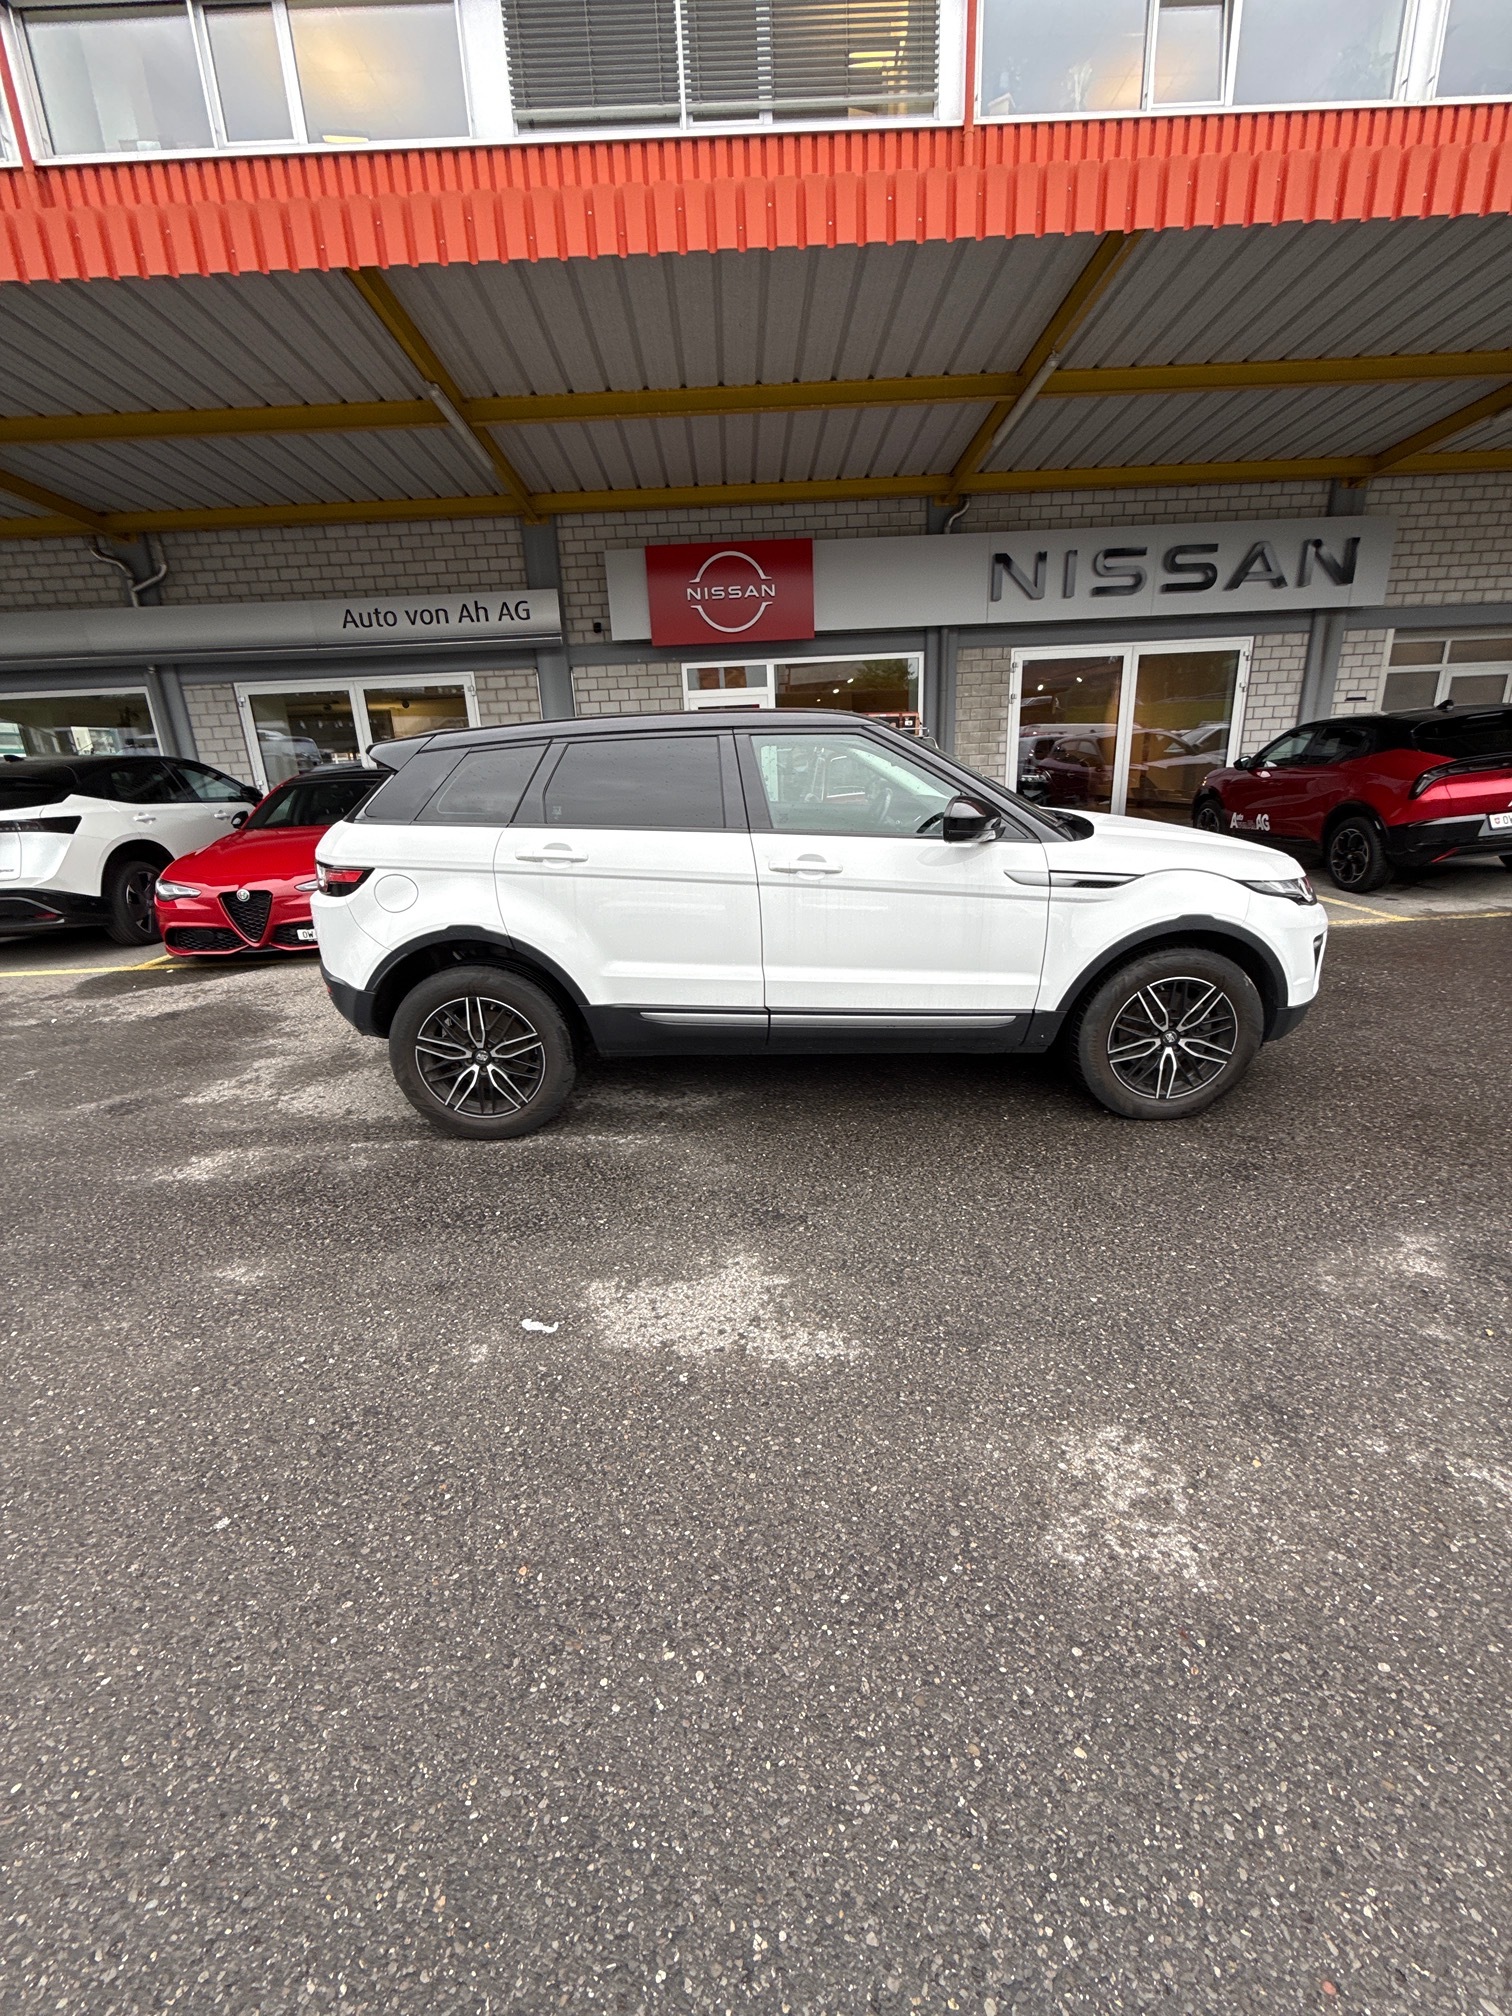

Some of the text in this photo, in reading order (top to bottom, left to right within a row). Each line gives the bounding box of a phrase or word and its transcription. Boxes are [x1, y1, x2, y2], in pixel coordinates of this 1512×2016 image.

[990, 537, 1361, 602] NISSAN
[687, 584, 776, 601] NISSAN
[342, 600, 531, 628] Auto von Ah AG
[1256, 813, 1270, 831] AG
